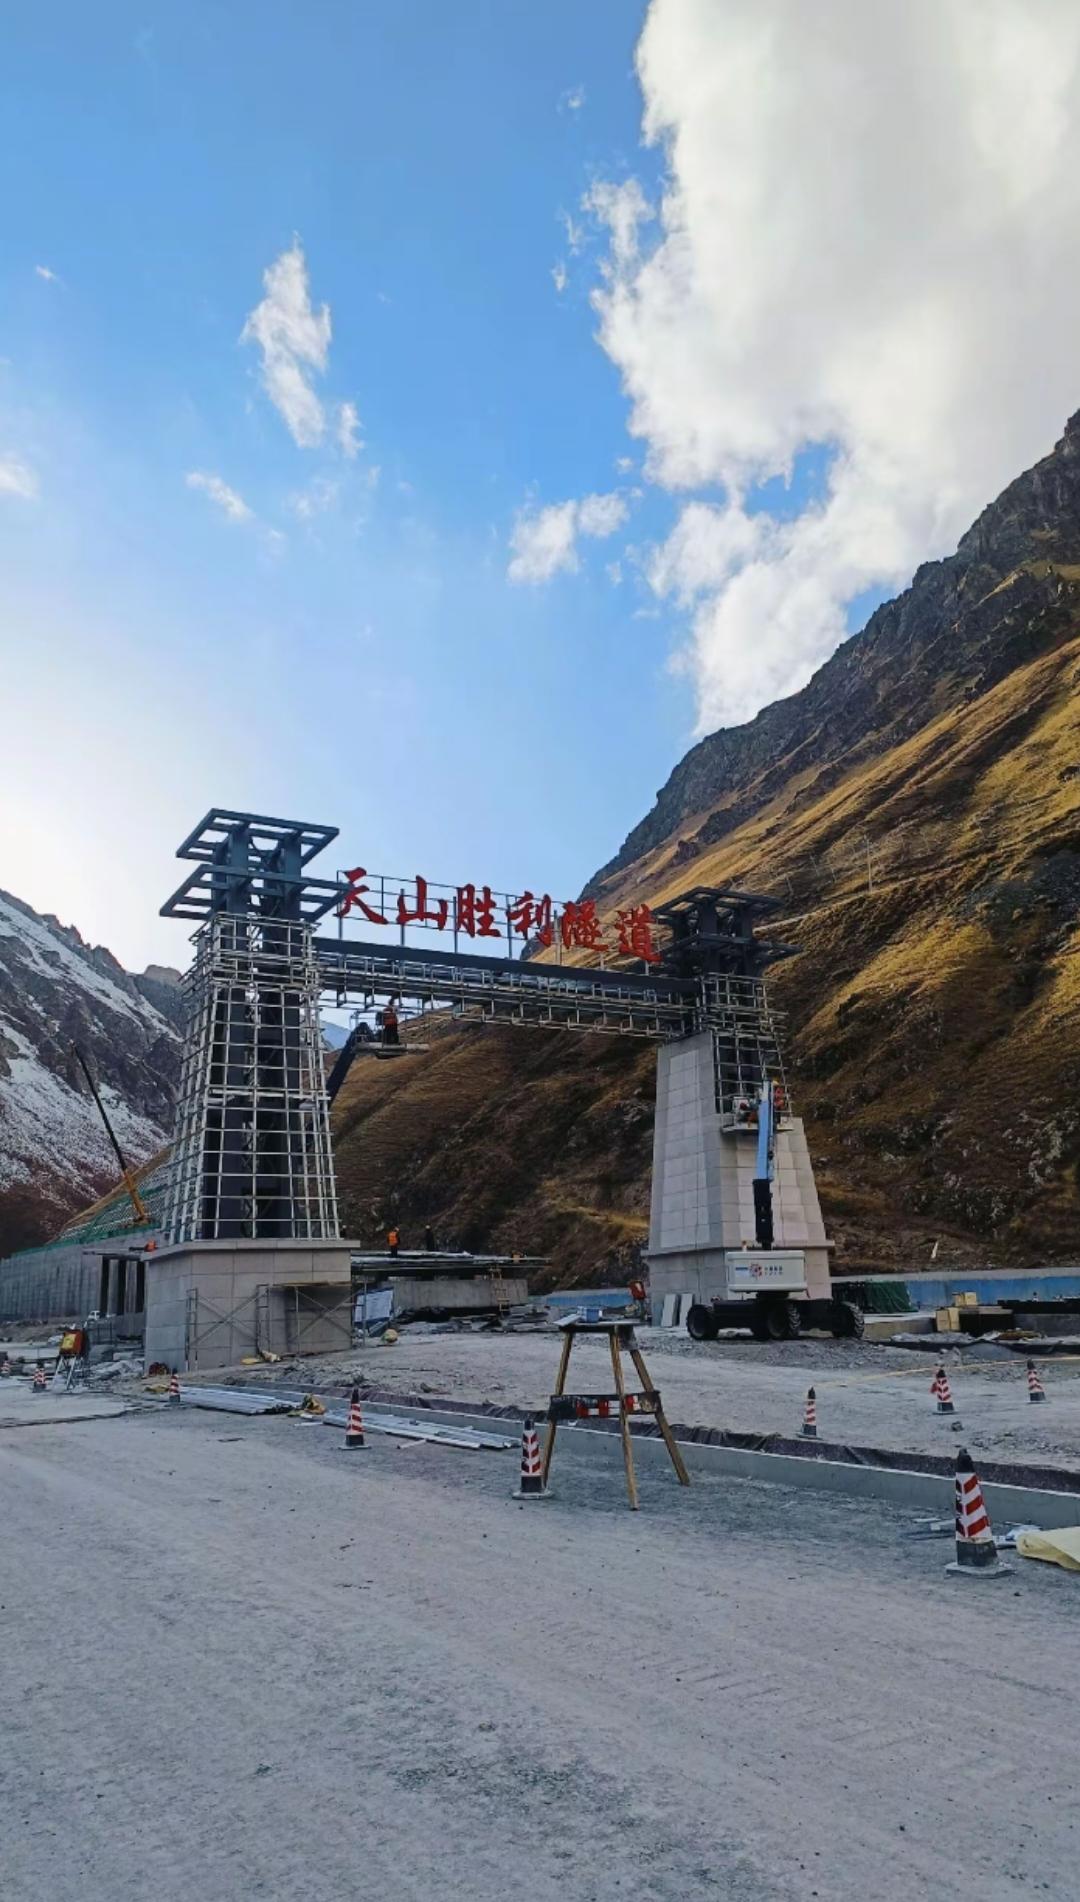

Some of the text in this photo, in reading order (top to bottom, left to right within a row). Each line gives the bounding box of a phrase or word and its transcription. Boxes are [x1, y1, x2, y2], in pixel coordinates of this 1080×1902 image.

[339, 867, 662, 962] 天山胜利隧道
